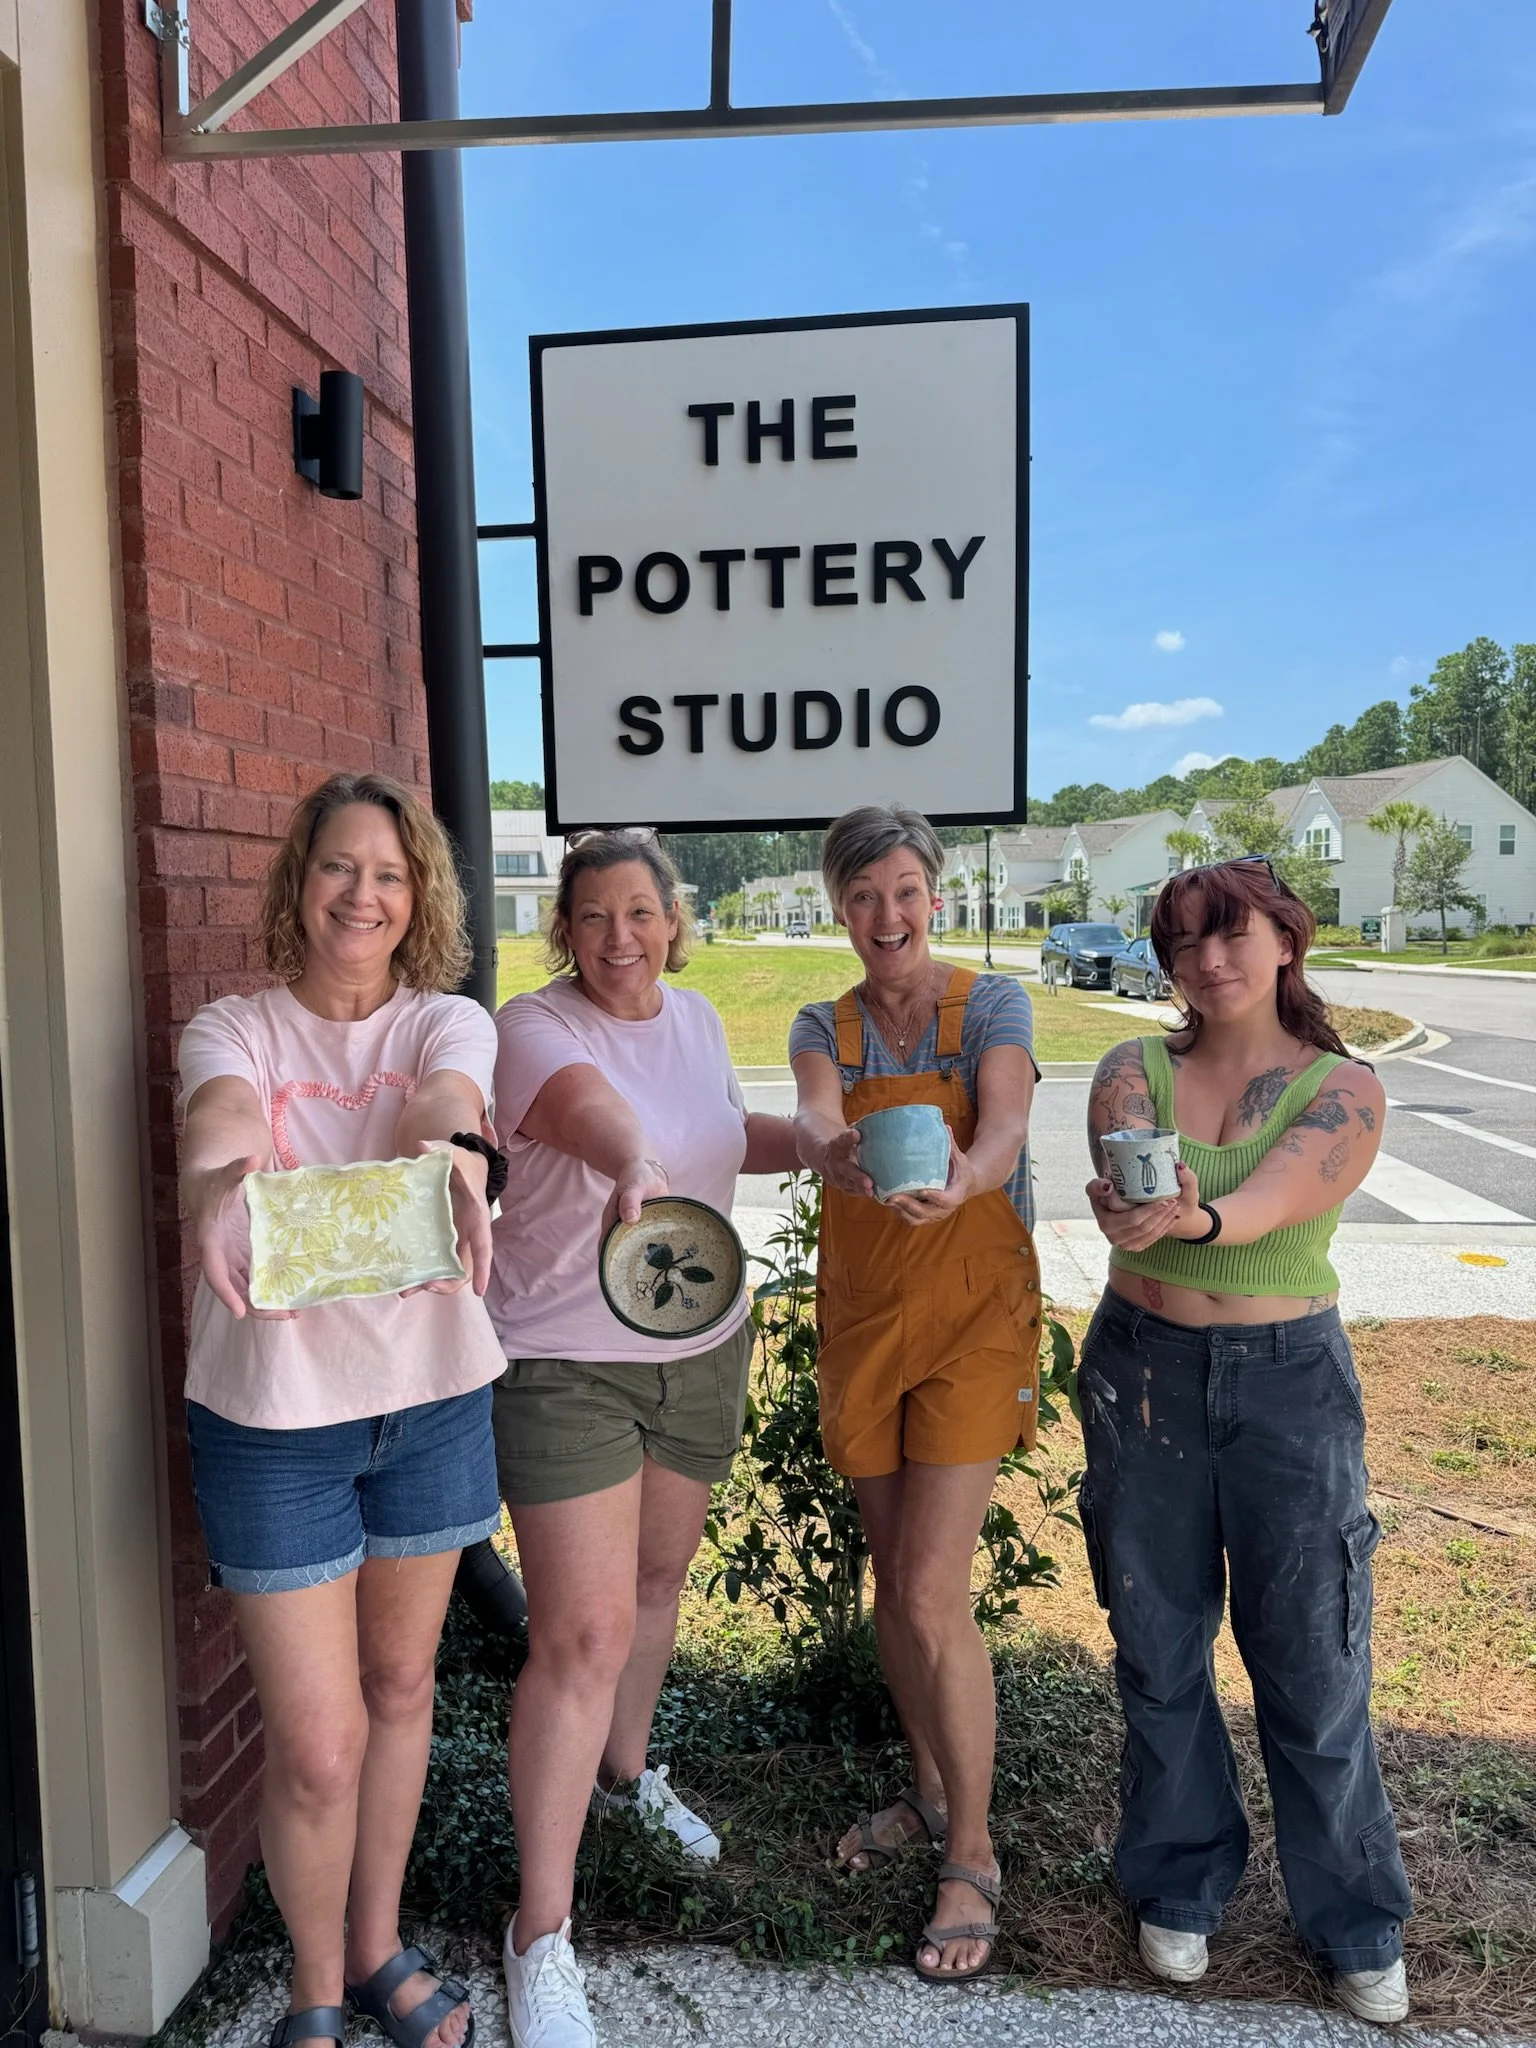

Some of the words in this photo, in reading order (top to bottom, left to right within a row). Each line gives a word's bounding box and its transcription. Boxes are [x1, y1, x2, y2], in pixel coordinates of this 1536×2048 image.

[688, 394, 858, 467] THE
[577, 535, 986, 617] POTTERY
[618, 685, 941, 756] STUDIO
